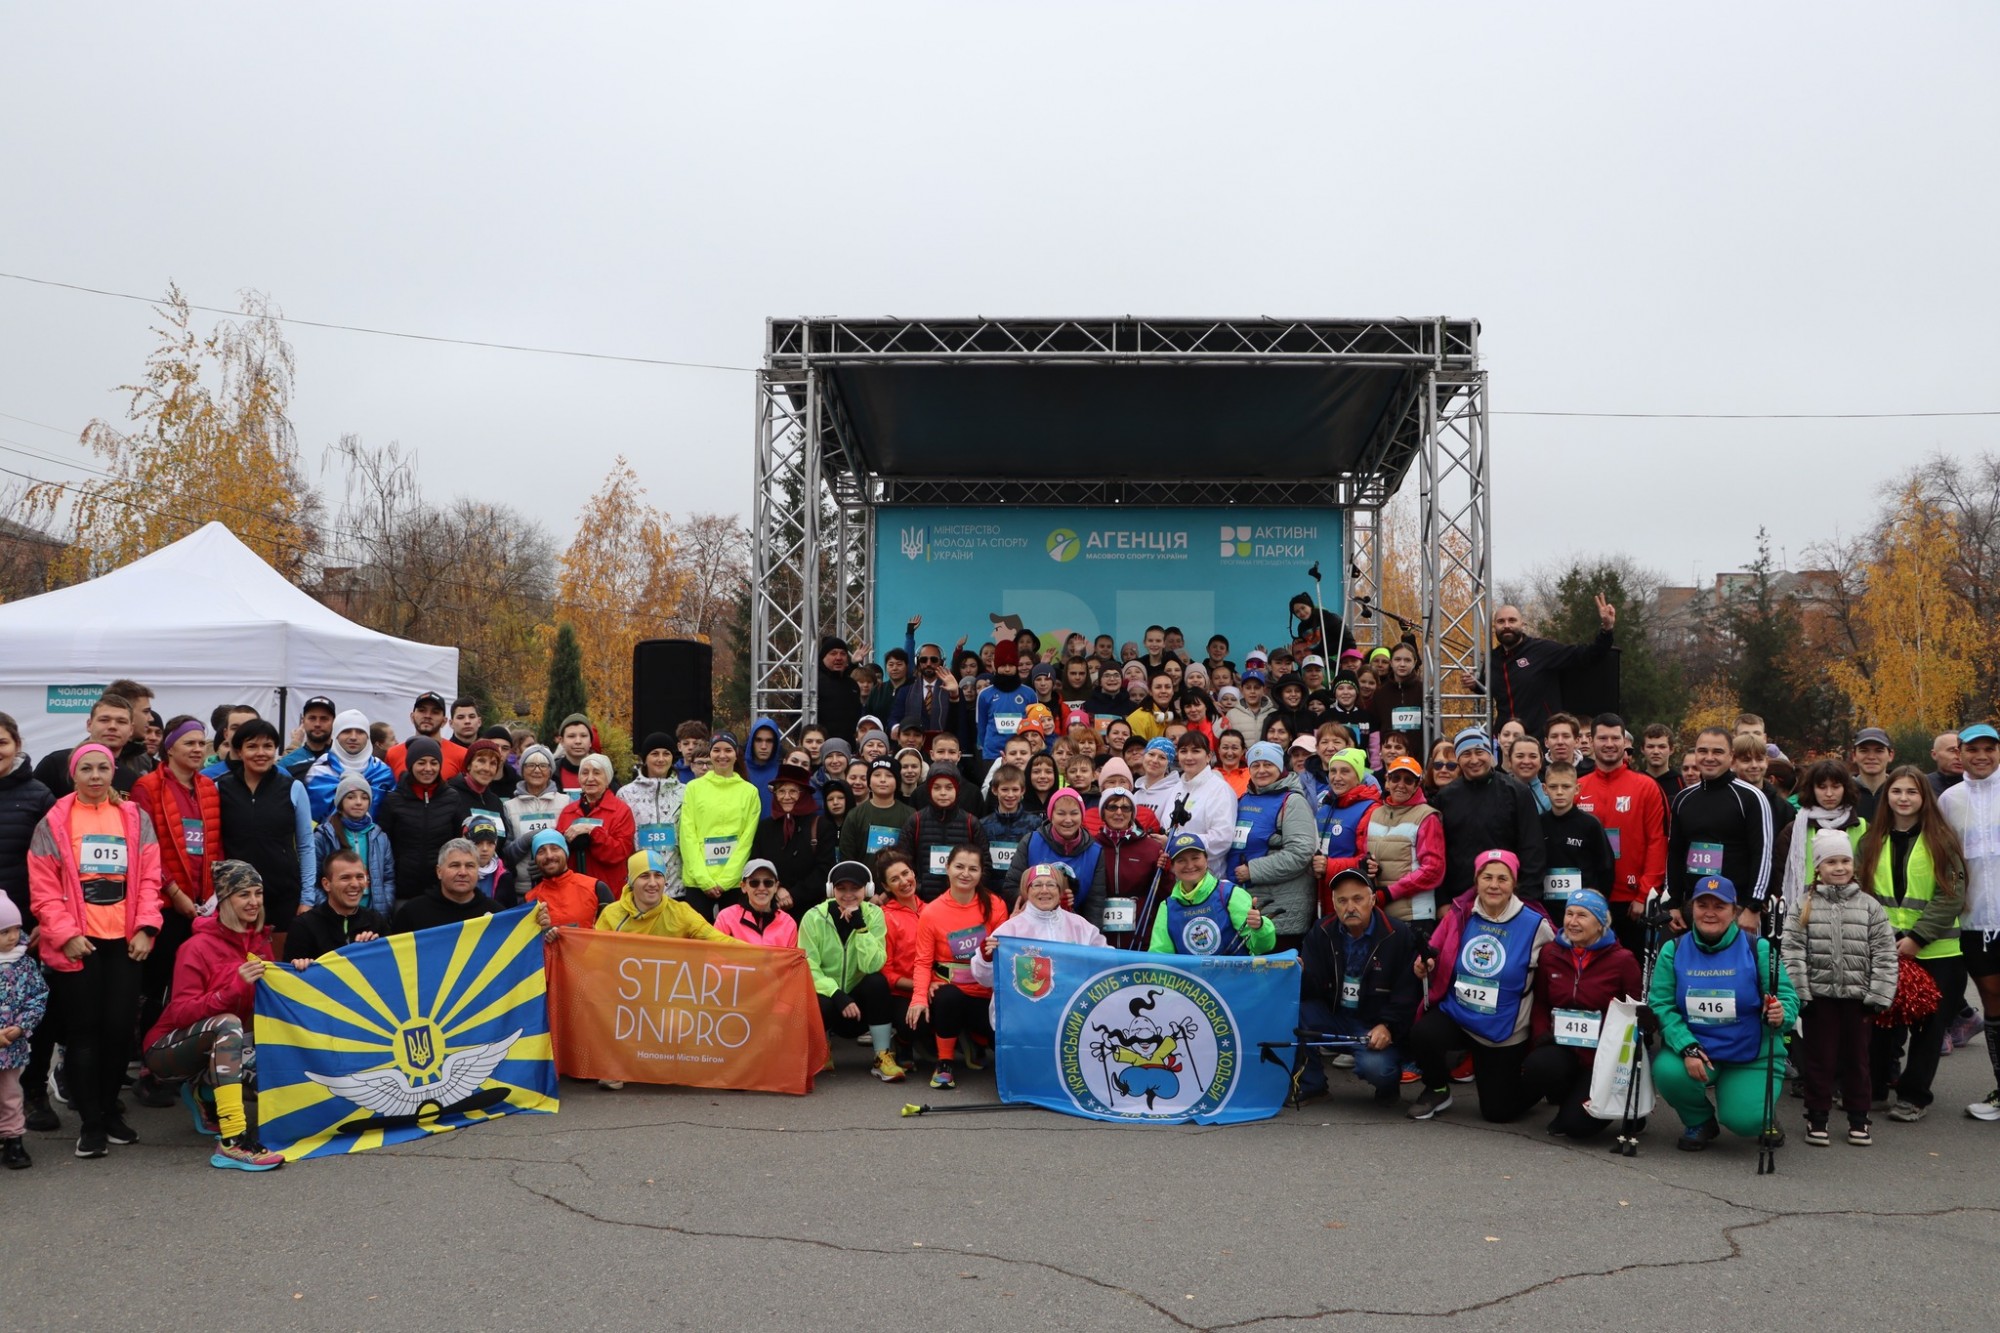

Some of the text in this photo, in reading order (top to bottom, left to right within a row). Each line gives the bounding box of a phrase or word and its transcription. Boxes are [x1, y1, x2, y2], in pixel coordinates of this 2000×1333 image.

[933, 525, 1001, 535] МІНІСТЕРСТВО
[1254, 526, 1317, 539] АКТИВНІ
[933, 538, 1028, 548] МОЛОДІ ТА СПОРТУ
[1086, 531, 1188, 551] АГЕНЦІЯ
[933, 550, 974, 560] УКРАЇНИ
[1156, 552, 1187, 560] УКРАЇНИ
[1255, 544, 1304, 557] ПАРКИ
[1398, 714, 1414, 722] 077
[648, 833, 666, 842] 583
[877, 835, 896, 846] 599
[1566, 837, 1583, 848] MN
[94, 848, 119, 860] 015
[713, 846, 731, 856] 007
[1692, 853, 1711, 864] 218
[1550, 879, 1570, 889] 033
[1103, 911, 1123, 921] 413
[1184, 906, 1212, 917] TRAINER
[958, 937, 978, 950] 207
[1693, 968, 1735, 978] UKRAINE
[618, 957, 756, 1007] START
[1343, 986, 1360, 997] 42
[1463, 988, 1486, 1001] 412
[1698, 1002, 1723, 1013] 416
[615, 1004, 751, 1048] DNIPRO
[1566, 1021, 1588, 1033] 418
[1061, 971, 1234, 1102] УКРАЇНСЬКИЙ КЛУБ СКАНДИНАВСЬКОЇ ХОДЬБИ
[637, 1050, 725, 1064] Наповни Місто Бігом
